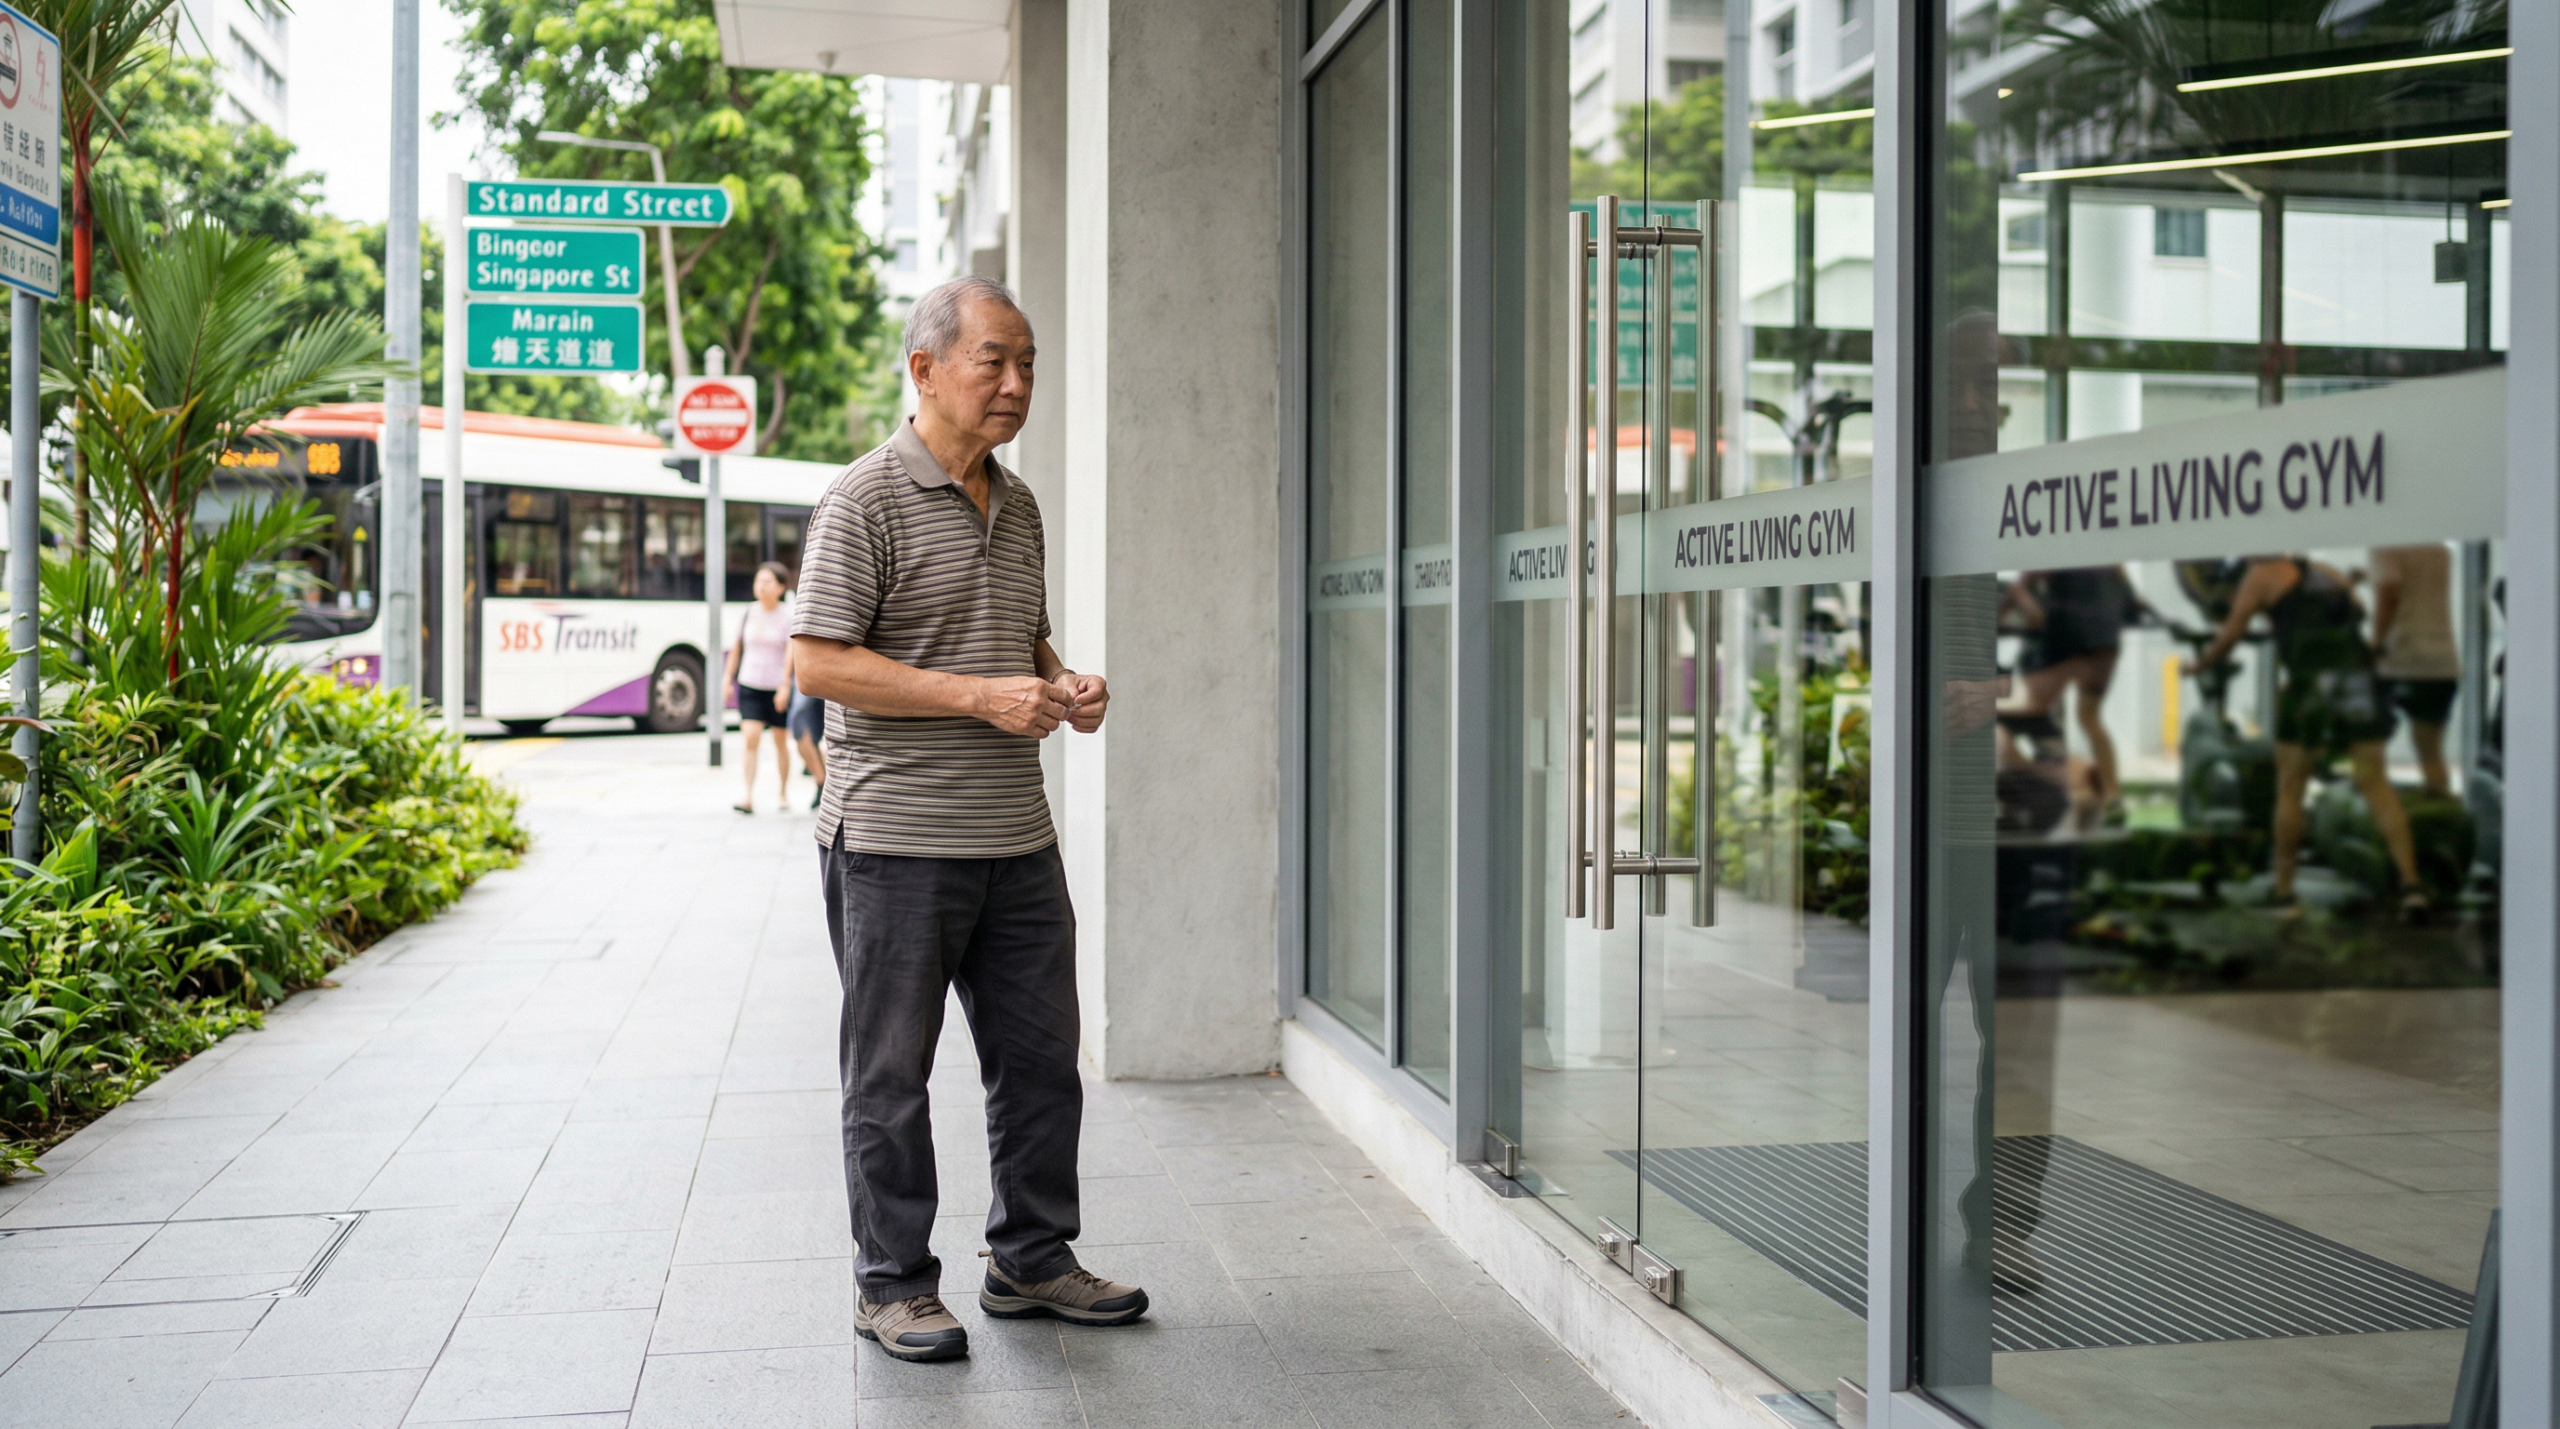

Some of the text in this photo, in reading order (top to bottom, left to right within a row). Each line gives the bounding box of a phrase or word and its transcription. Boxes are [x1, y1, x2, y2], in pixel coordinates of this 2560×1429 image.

[478, 185, 714, 218] Standard Street
[476, 262, 631, 291] Singapore St
[512, 309, 594, 332] Marain
[1999, 431, 2386, 538] ACTIVE LIVING GYM
[1674, 506, 1855, 568] ACTIVE LIVING GYM
[1508, 540, 1595, 582] ACTIVE LIVG
[499, 614, 638, 655] SBS Transit
